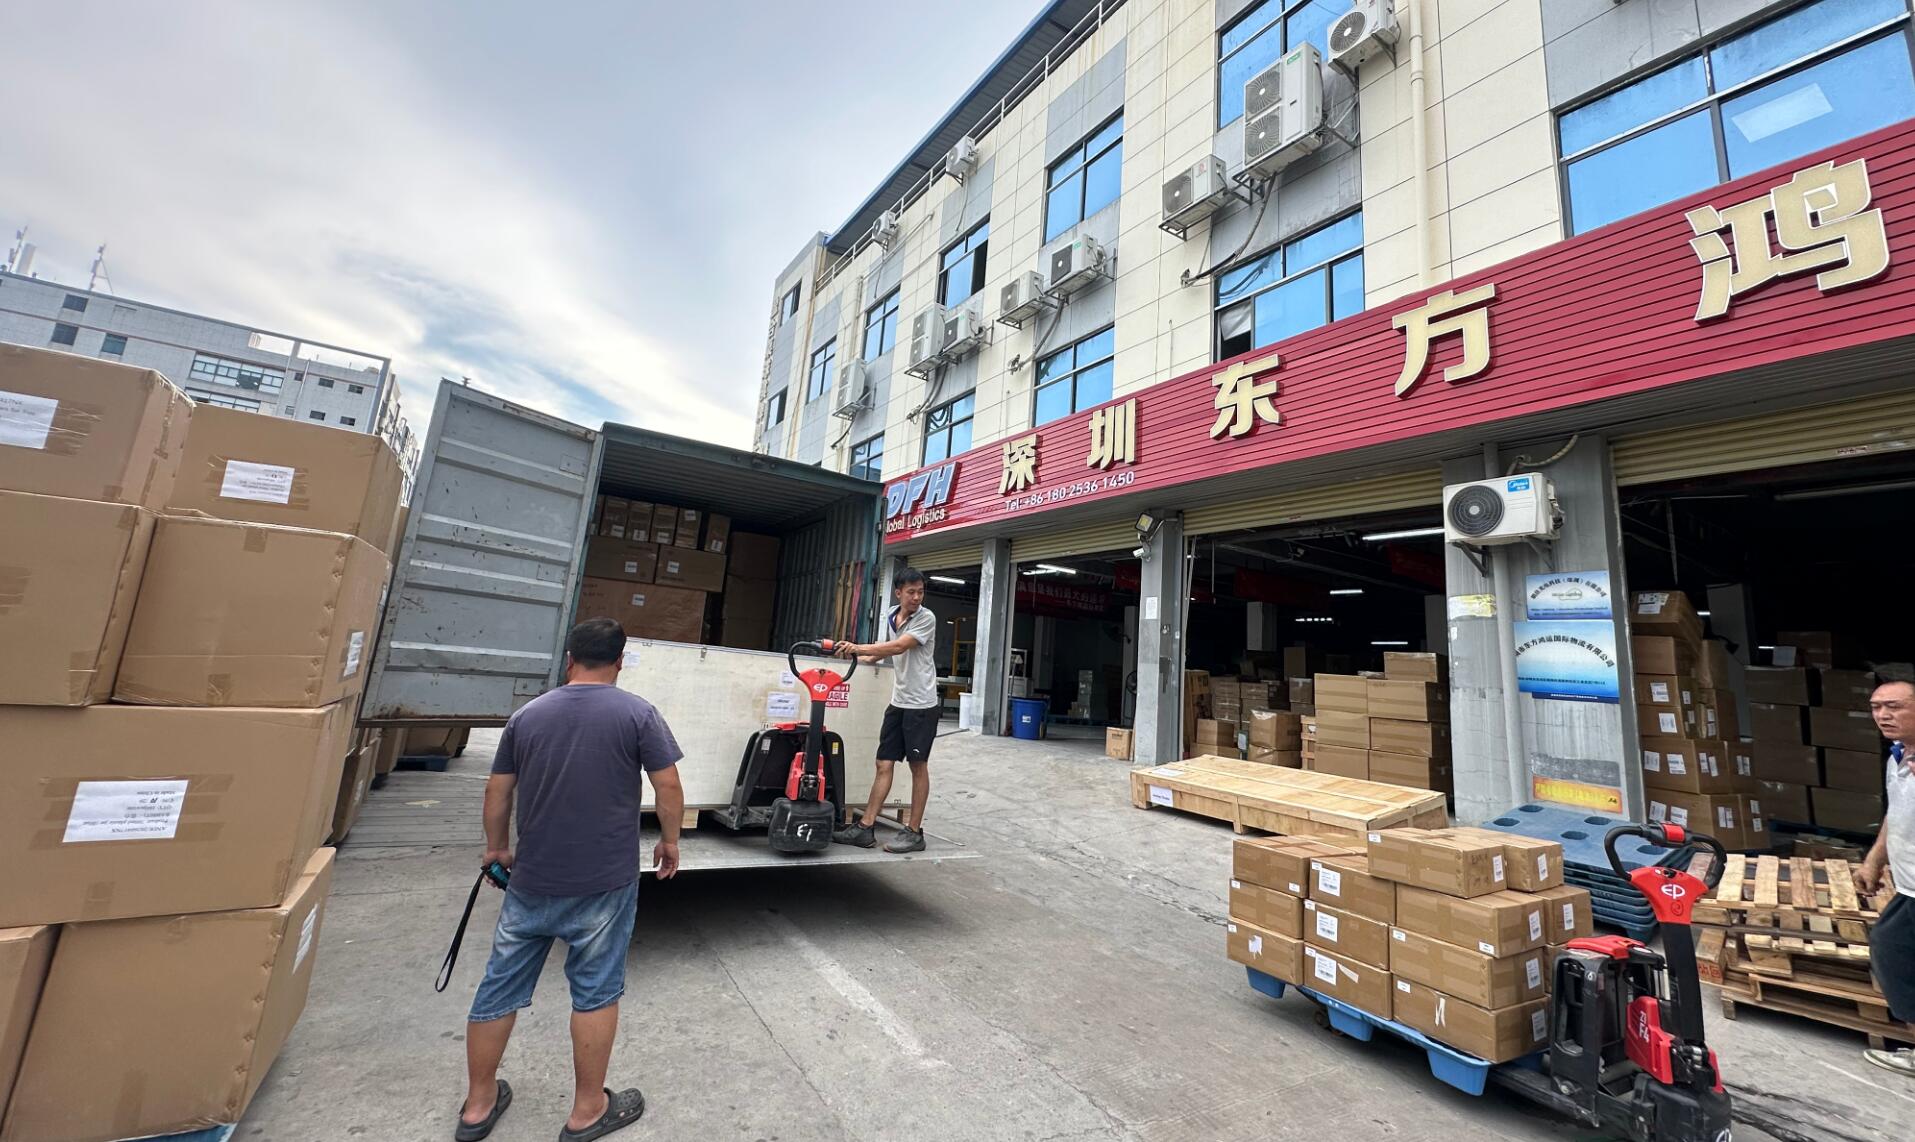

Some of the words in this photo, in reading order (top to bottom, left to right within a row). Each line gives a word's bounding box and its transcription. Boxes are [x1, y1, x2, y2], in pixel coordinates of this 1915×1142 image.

[886, 461, 957, 518] DFH
[1005, 498, 1022, 511] Tel:
[1024, 493, 1043, 506] +86
[1047, 487, 1066, 501] 180
[1069, 480, 1098, 496] 2536
[1102, 471, 1135, 489] 1450
[886, 516, 905, 532] lobal
[908, 508, 945, 528] Logistics
[827, 692, 849, 700] AGILE
[1660, 883, 1686, 900] EP
